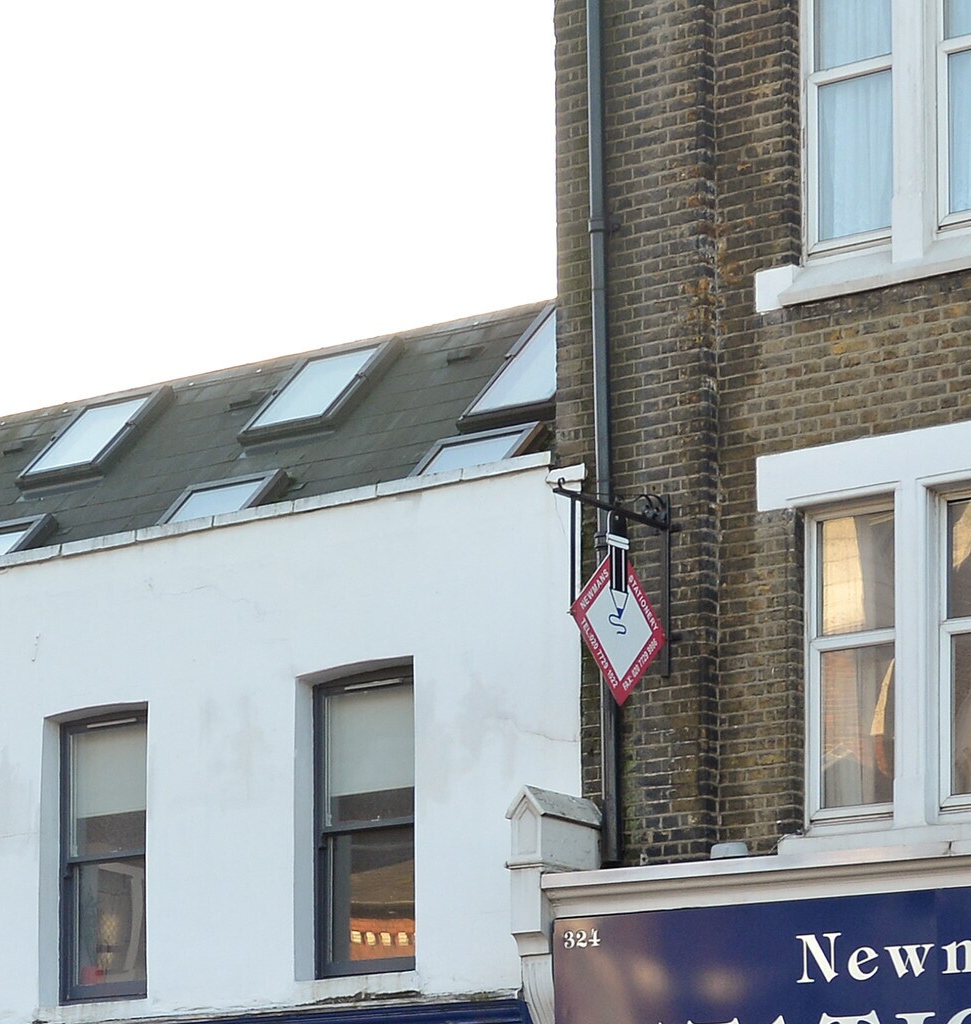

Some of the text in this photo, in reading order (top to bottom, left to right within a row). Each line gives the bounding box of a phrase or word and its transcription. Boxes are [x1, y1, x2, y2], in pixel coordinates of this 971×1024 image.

[580, 568, 609, 610] NEWMANS
[628, 574, 659, 631] STATIONERY
[563, 928, 601, 949] 324
